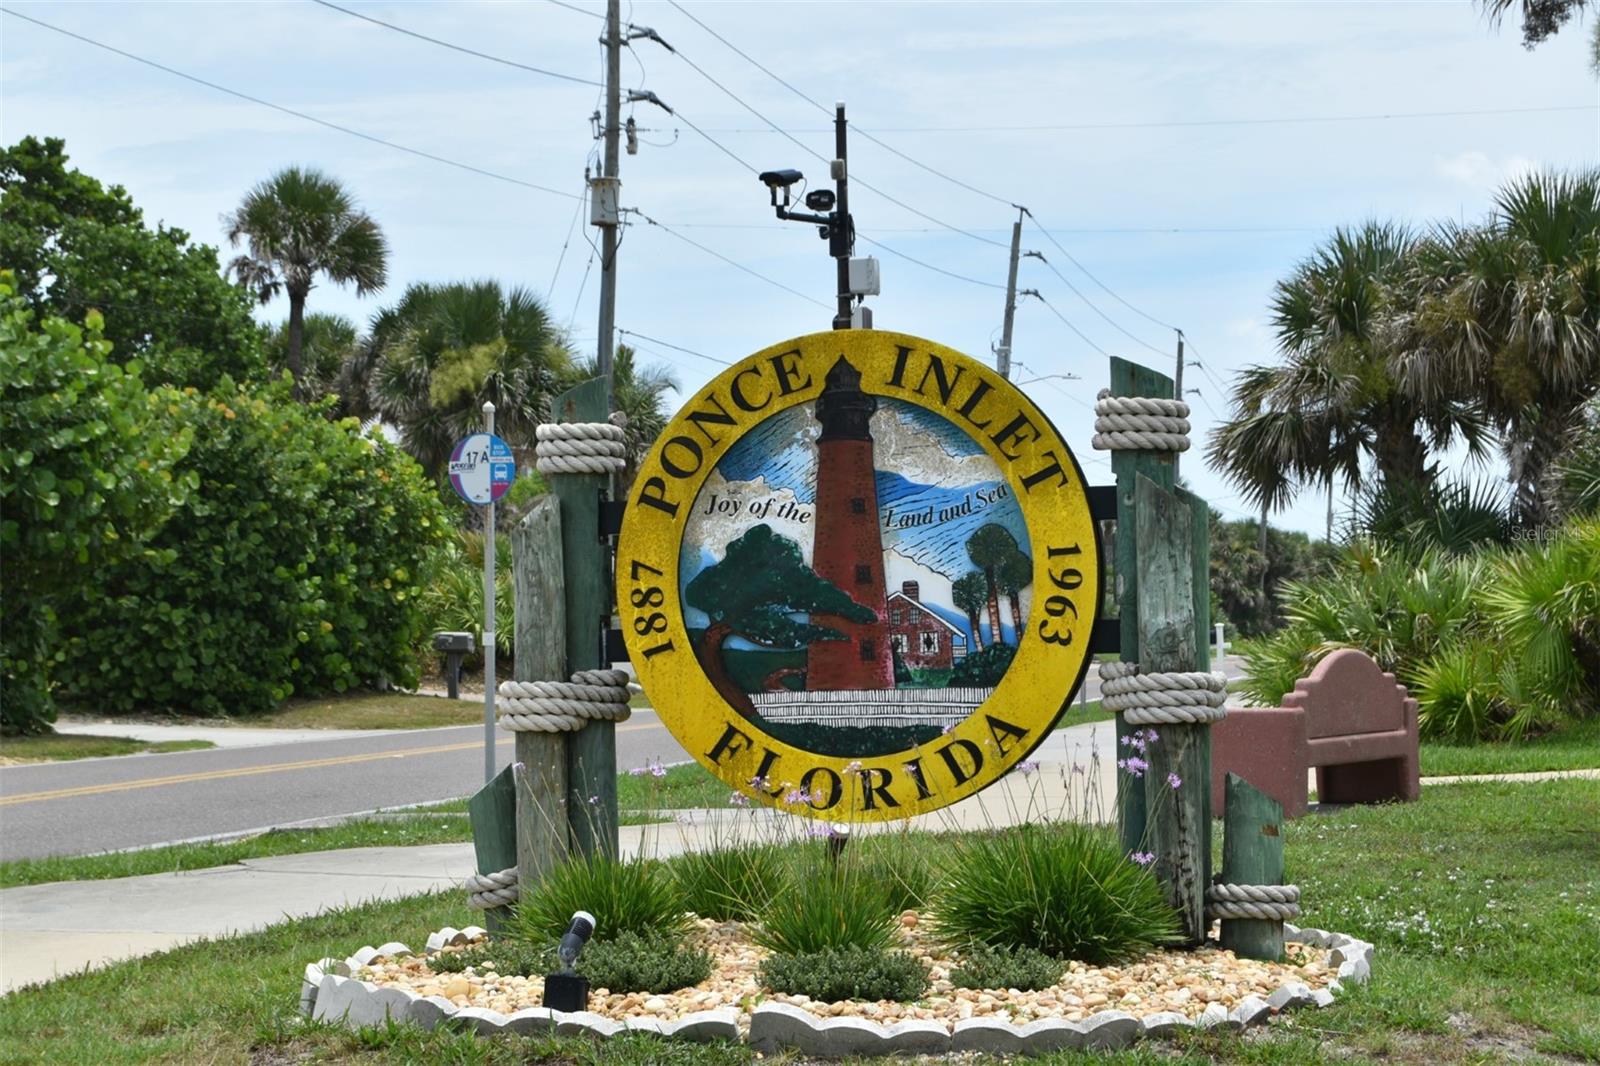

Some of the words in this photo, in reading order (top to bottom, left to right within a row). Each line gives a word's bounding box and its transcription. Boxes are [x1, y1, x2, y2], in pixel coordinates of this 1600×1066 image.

[466, 451, 478, 465] 17
[480, 451, 489, 463] A
[636, 348, 813, 519] PONCE
[886, 344, 1069, 495] INLET
[704, 494, 742, 516] Joy
[749, 498, 776, 519] of
[777, 501, 811, 523] the
[885, 506, 933, 527] Land
[938, 495, 972, 522] and
[975, 484, 1008, 509] Sea
[630, 559, 676, 660] 1887
[1038, 542, 1083, 648] 1963
[704, 714, 1031, 812] FLORIDA
